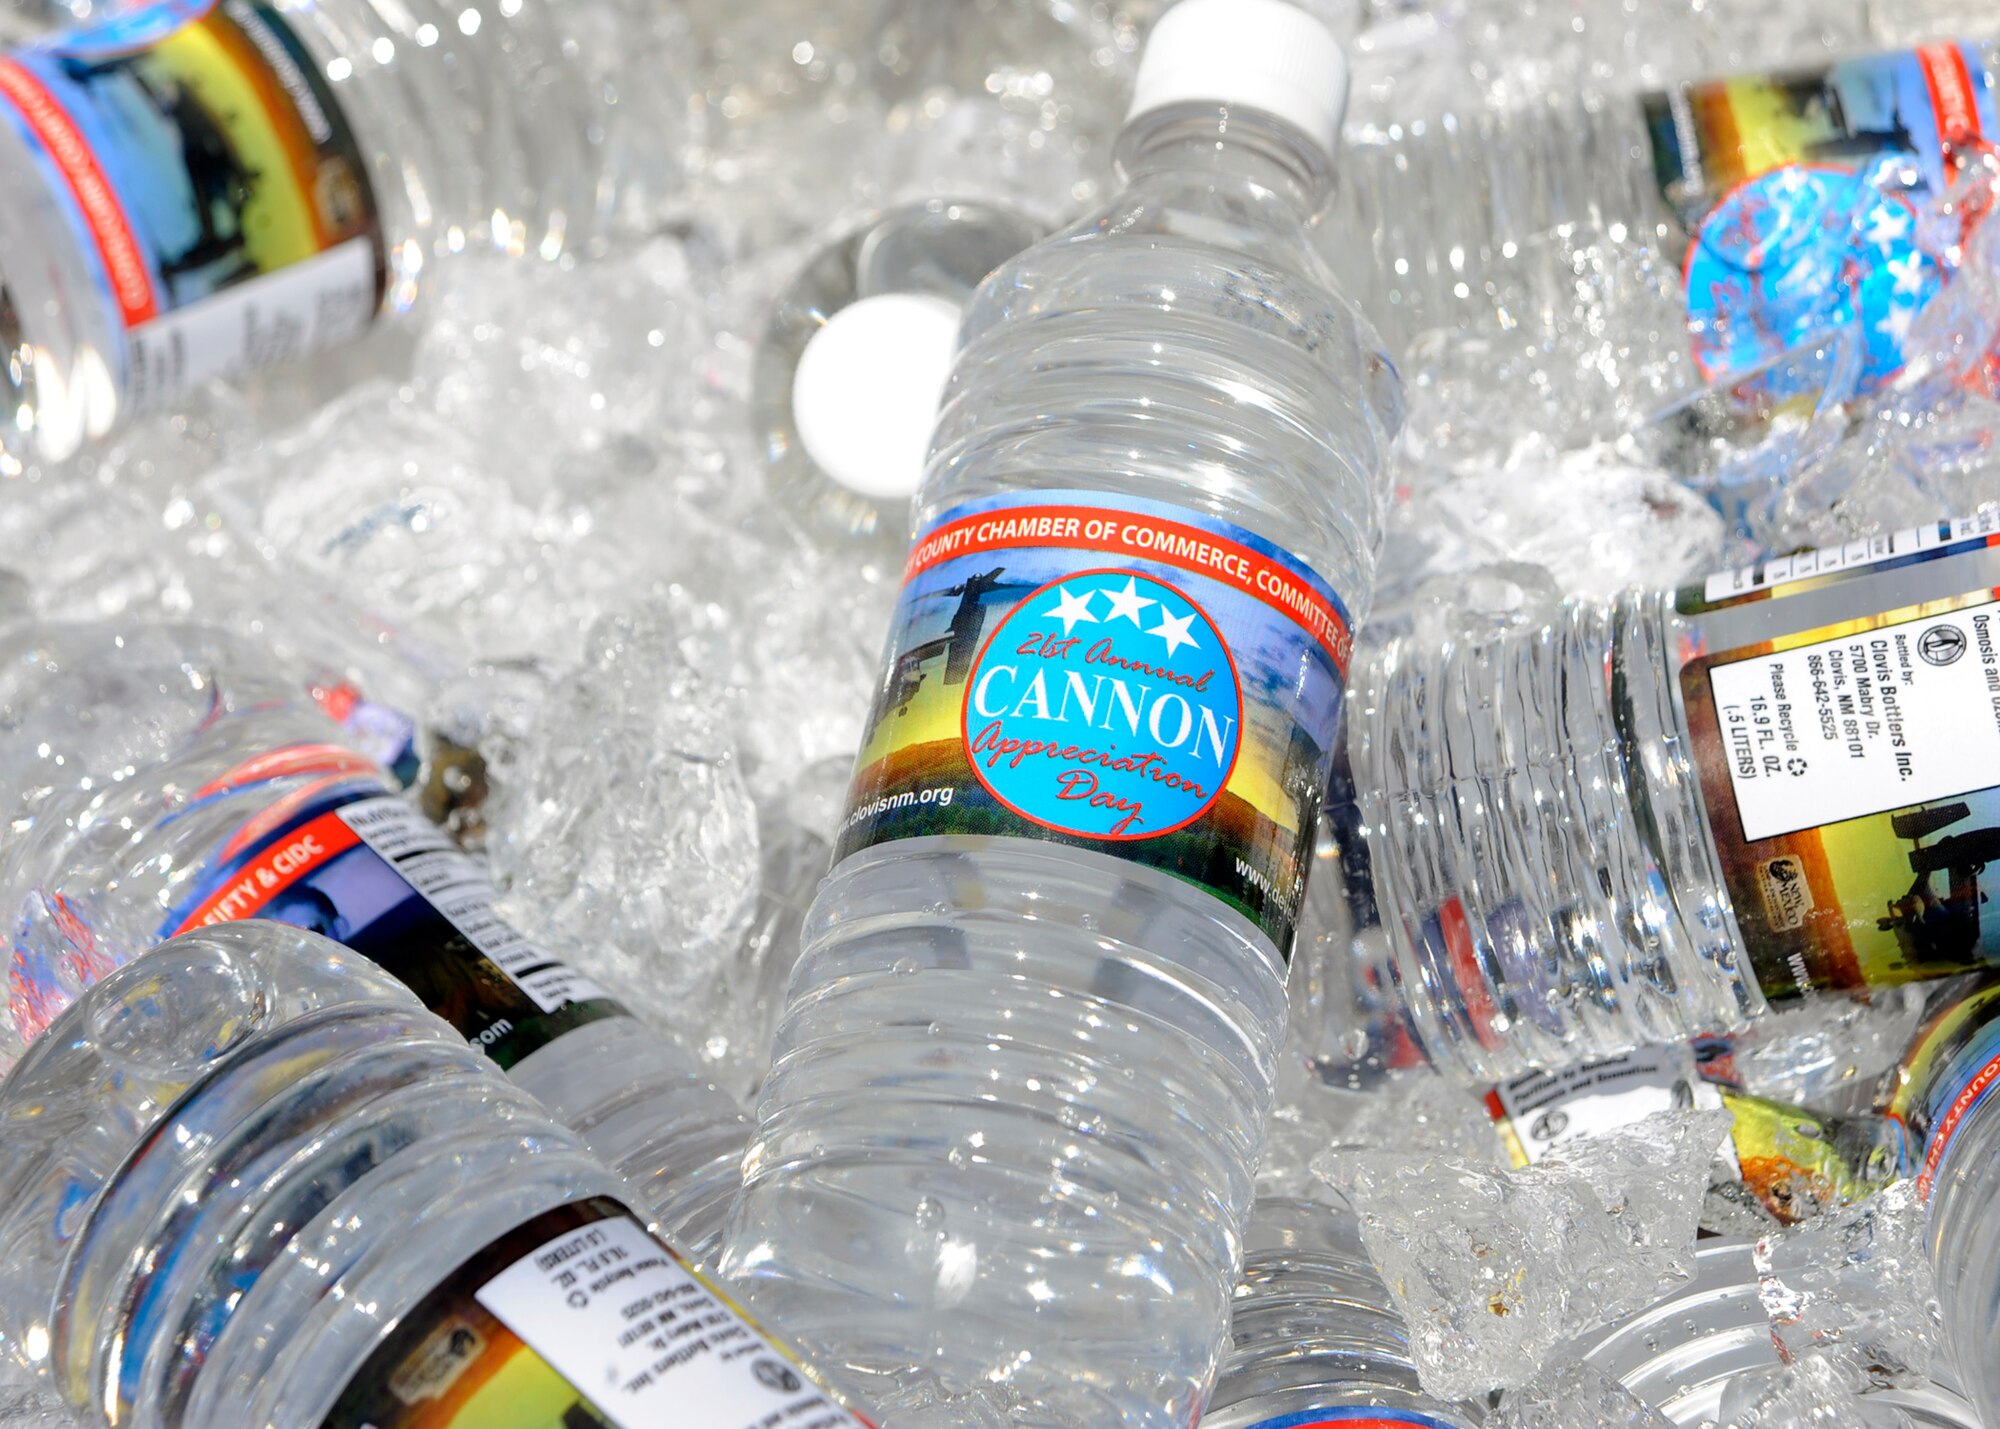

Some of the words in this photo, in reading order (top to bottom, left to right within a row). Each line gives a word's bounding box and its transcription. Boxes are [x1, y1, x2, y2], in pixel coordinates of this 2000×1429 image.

[915, 525, 976, 568] COUNTY
[977, 517, 1080, 543] CHAMBER
[1083, 519, 1118, 541] OF
[1121, 524, 1252, 585] COMMERCE,
[1255, 569, 1338, 649] COMMITTEE
[1849, 644, 1869, 675] 5700
[1894, 634, 1911, 669] Bottled
[1973, 614, 1998, 665] Osmosis
[1016, 632, 1083, 660] 21st
[1084, 638, 1216, 693] Annual
[1828, 649, 1848, 690] Clovis,
[1870, 639, 1892, 683] Clovis
[1901, 669, 1914, 686] by:
[1769, 663, 1786, 701] Please
[1806, 654, 1839, 741] 866-642-5525
[1856, 676, 1875, 718] Mabry
[973, 665, 1236, 769] CANNON
[1723, 704, 1745, 724] (.5
[1750, 695, 1771, 726] 16.9
[1837, 694, 1856, 716] NM
[1880, 685, 1906, 748] Bottlers
[1756, 727, 1775, 751] FL.
[1777, 702, 1798, 752] Recycle
[1843, 719, 1866, 760] 88101
[1866, 720, 1881, 740] Dr.
[971, 719, 1208, 799] Appreciation
[1730, 725, 1758, 780] LITERS)
[1762, 754, 1782, 778] OZ.
[1895, 750, 1913, 783] Inc.
[1055, 768, 1145, 835] Day
[203, 877, 260, 926] FIFTY
[255, 866, 280, 889] &
[272, 834, 325, 875] CIDC
